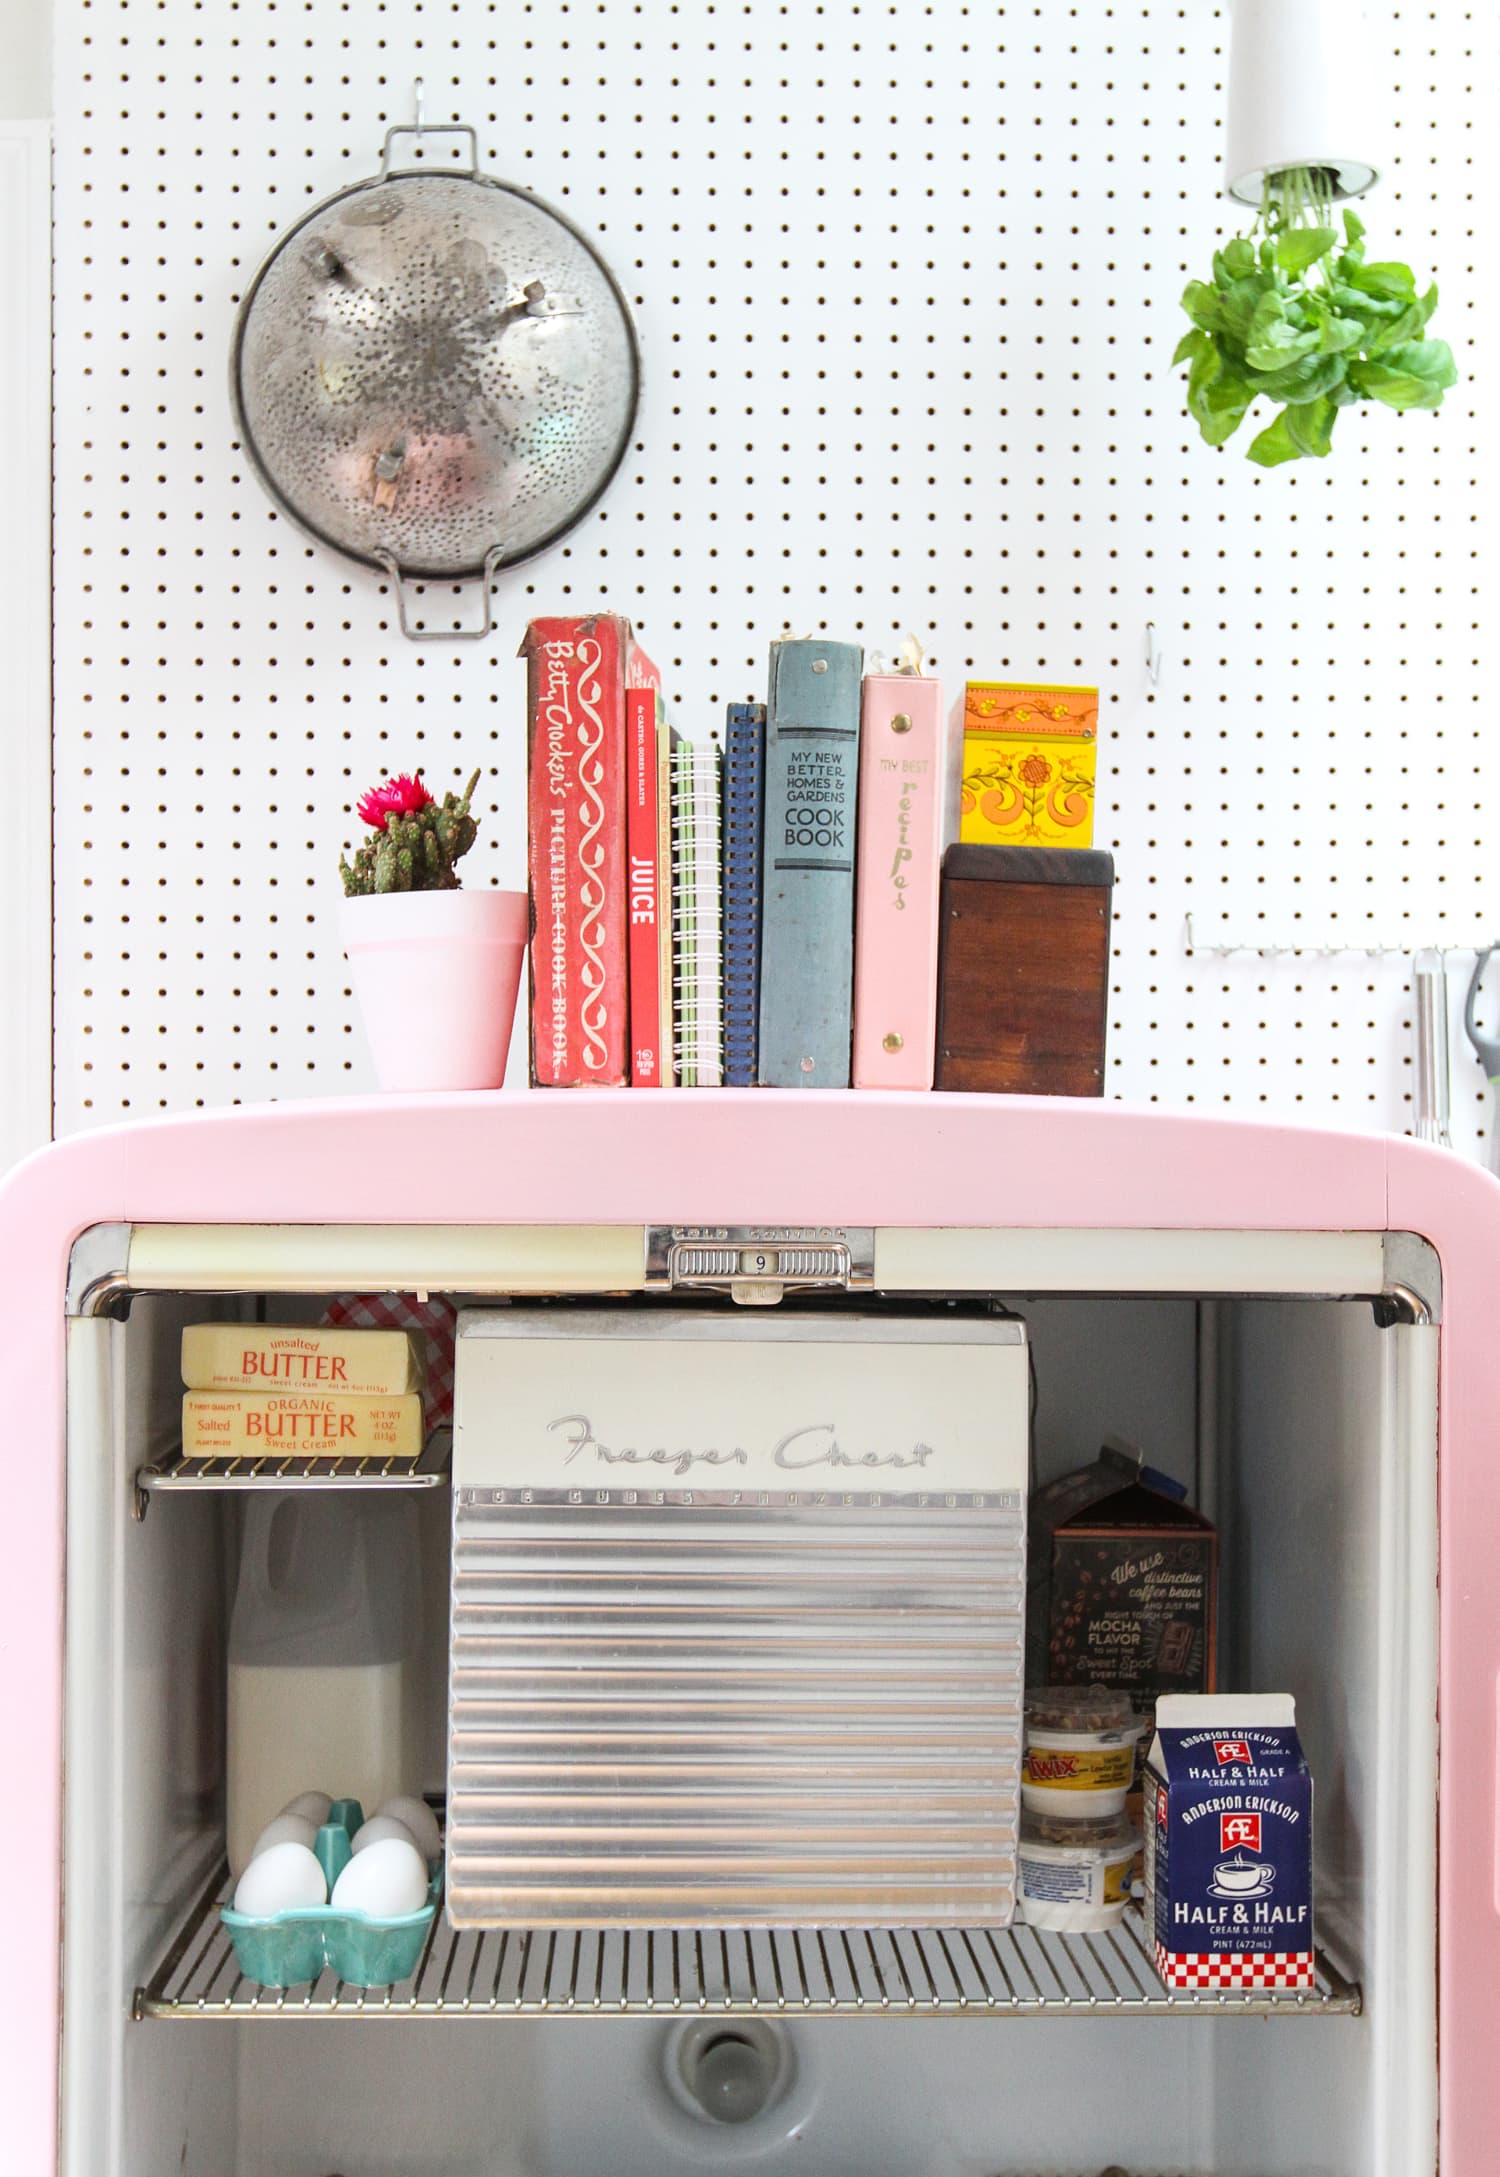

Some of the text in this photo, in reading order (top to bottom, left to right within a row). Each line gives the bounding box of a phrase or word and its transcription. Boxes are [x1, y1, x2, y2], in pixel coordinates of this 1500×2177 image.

[791, 752, 842, 764] MY NEW
[788, 765, 845, 777] BETTER
[902, 760, 928, 773] BEST
[787, 778, 845, 789] HOMES &
[787, 791, 845, 803] GARDENS
[785, 809, 844, 826] COOK
[785, 829, 844, 847] BOOK
[539, 640, 574, 1068] Betty Crocker's PICTURE COOK BOOK
[632, 856, 654, 924] JUICE
[756, 1256, 766, 1270] 9
[270, 1338, 320, 1352] unsalted
[242, 1351, 348, 1381] BUTTER
[267, 1398, 335, 1412] ORGANIC
[197, 1419, 230, 1432] Salted
[246, 1413, 357, 1438] BUTTER
[265, 1437, 337, 1450] Sweet Cream
[546, 1414, 934, 1475] Freezer Chest
[1110, 1552, 1165, 1585] We use
[1144, 1572, 1203, 1584] distinctive
[1129, 1585, 1202, 1602] coffee beans
[1088, 1620, 1141, 1632] MOCHA
[1088, 1633, 1141, 1645] FLAVOR
[1120, 1655, 1153, 1673] Spot
[1180, 1731, 1280, 1749] ANDERSON ERICKSON
[1189, 1767, 1285, 1779] HALF & HALF
[1209, 1779, 1237, 1787] CREAM
[1181, 1796, 1300, 1824] ANDERSON ERICKSON
[1174, 1902, 1307, 1924] HALF & HALF
[1210, 1926, 1274, 1934] CREAM & MILK
[1213, 1940, 1272, 1949] PINT (472mL)
